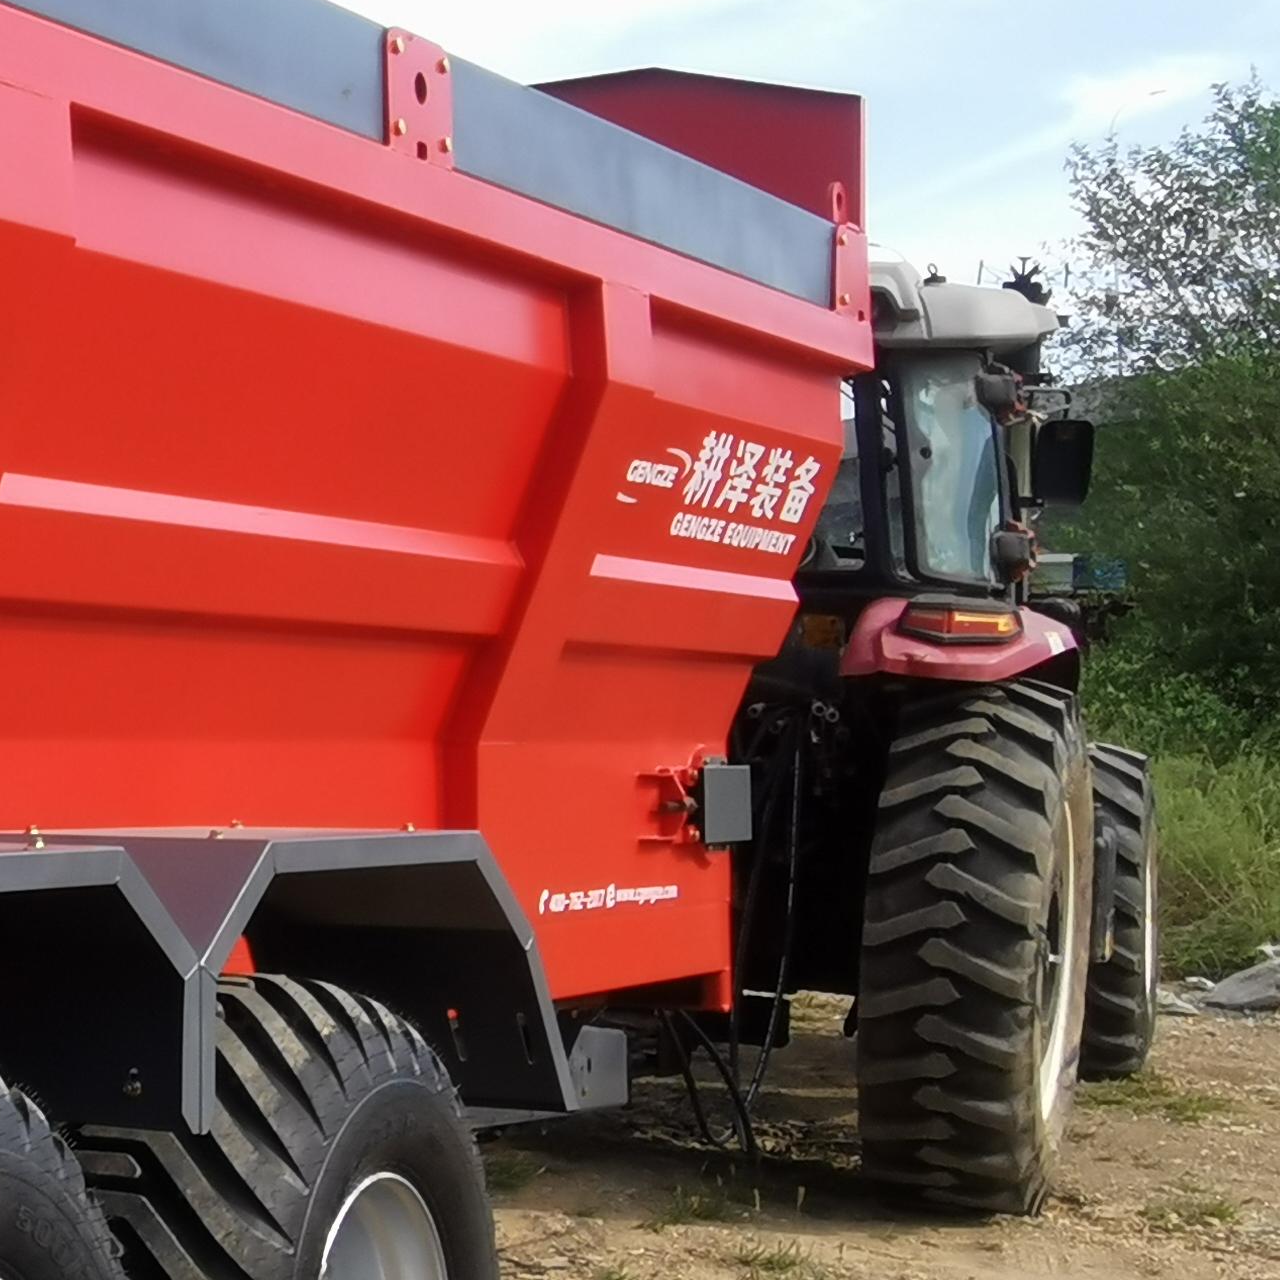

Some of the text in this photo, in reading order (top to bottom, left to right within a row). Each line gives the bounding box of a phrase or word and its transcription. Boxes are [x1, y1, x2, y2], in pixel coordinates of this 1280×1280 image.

[626, 459, 679, 488] GENGZE
[683, 430, 821, 524] 耕泽装备
[670, 512, 796, 555] GENGZE EQUIPMENT
